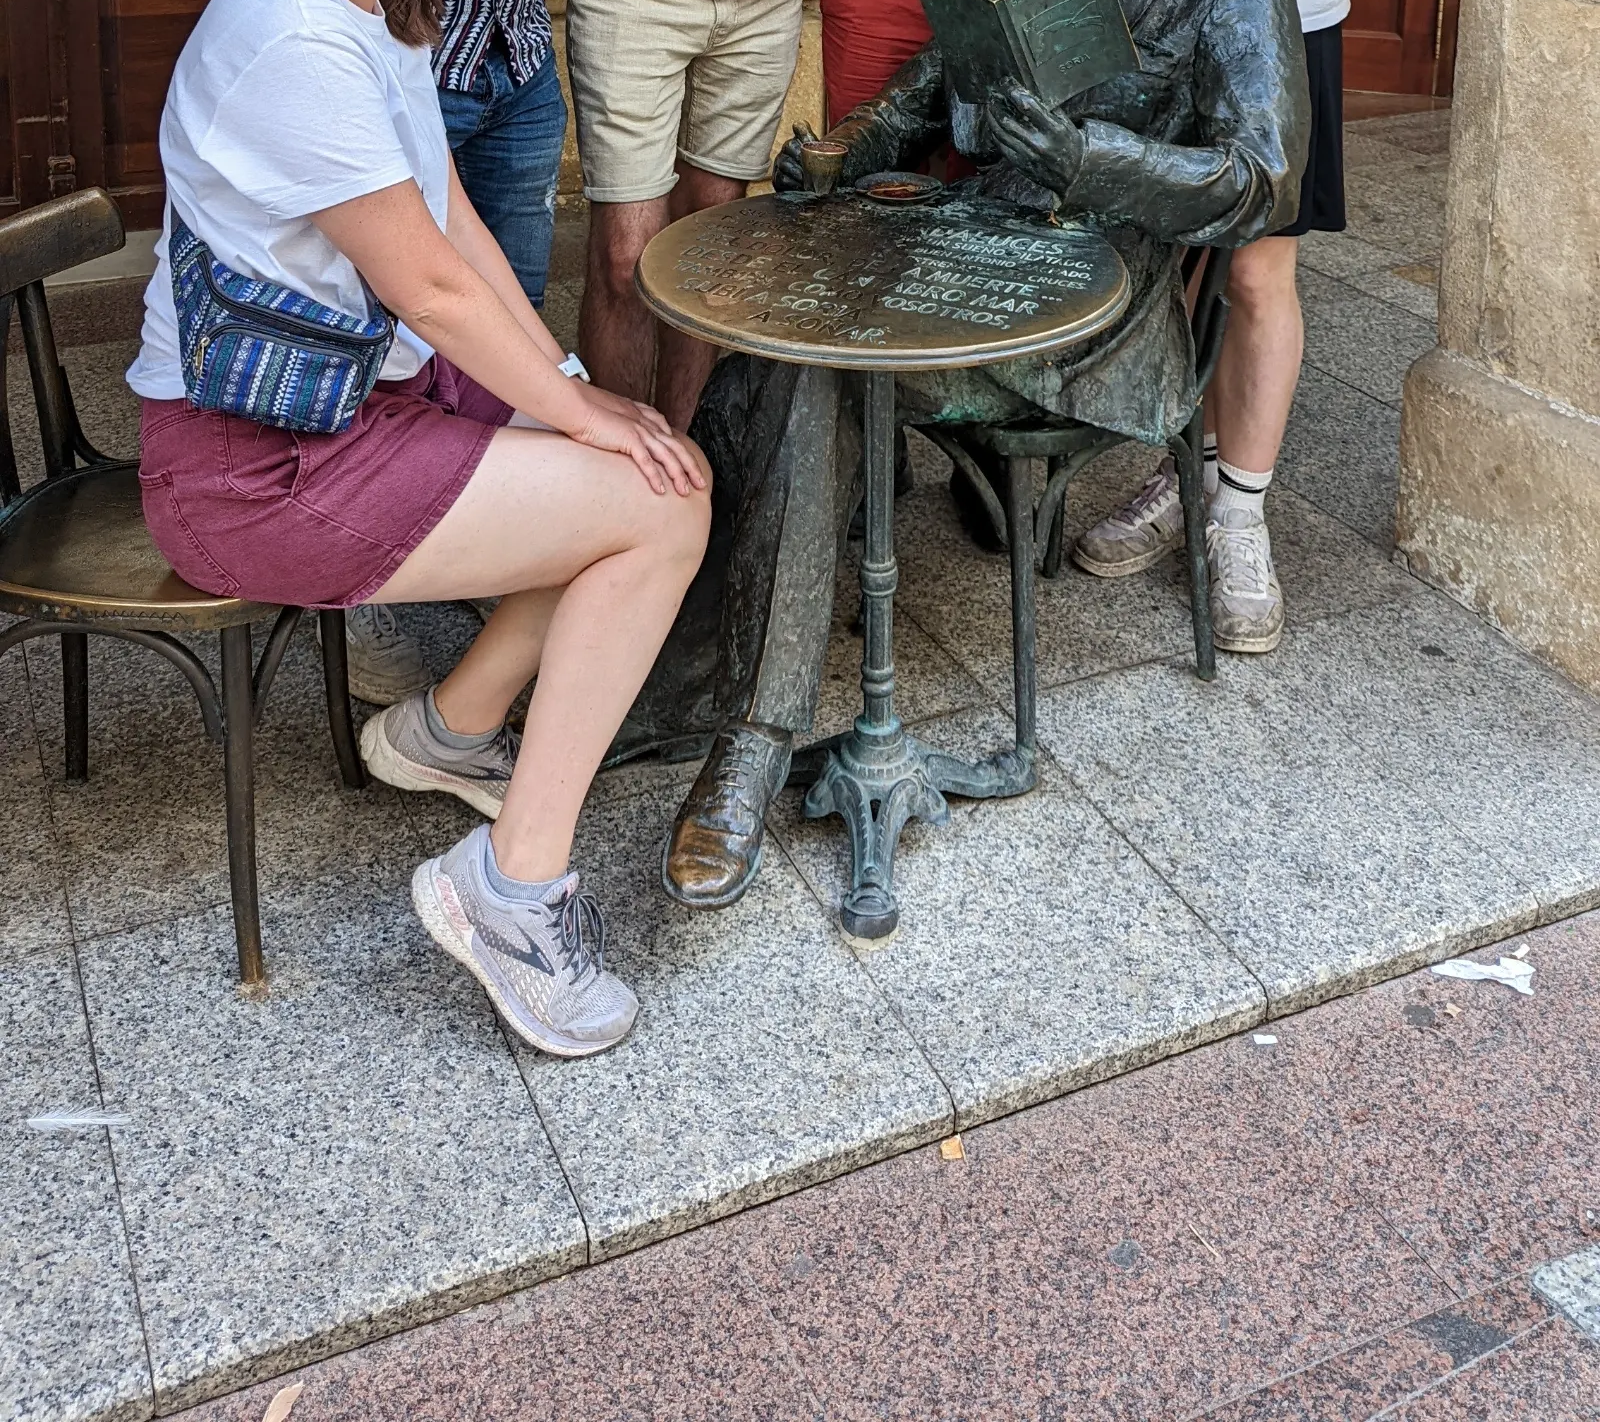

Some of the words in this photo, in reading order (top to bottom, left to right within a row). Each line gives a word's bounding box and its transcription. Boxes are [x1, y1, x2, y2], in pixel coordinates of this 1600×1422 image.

[1059, 53, 1091, 73] SORIA
[918, 228, 1067, 255] DALUCES
[681, 246, 773, 267] DESDE
[772, 261, 805, 275] EL
[969, 294, 1039, 315] MAR
[788, 281, 864, 300] COMO
[925, 270, 1040, 297] MUERTE
[1028, 275, 1087, 290] CRUCES
[743, 291, 769, 305] A
[773, 295, 863, 321] SORIA
[746, 309, 773, 324] A
